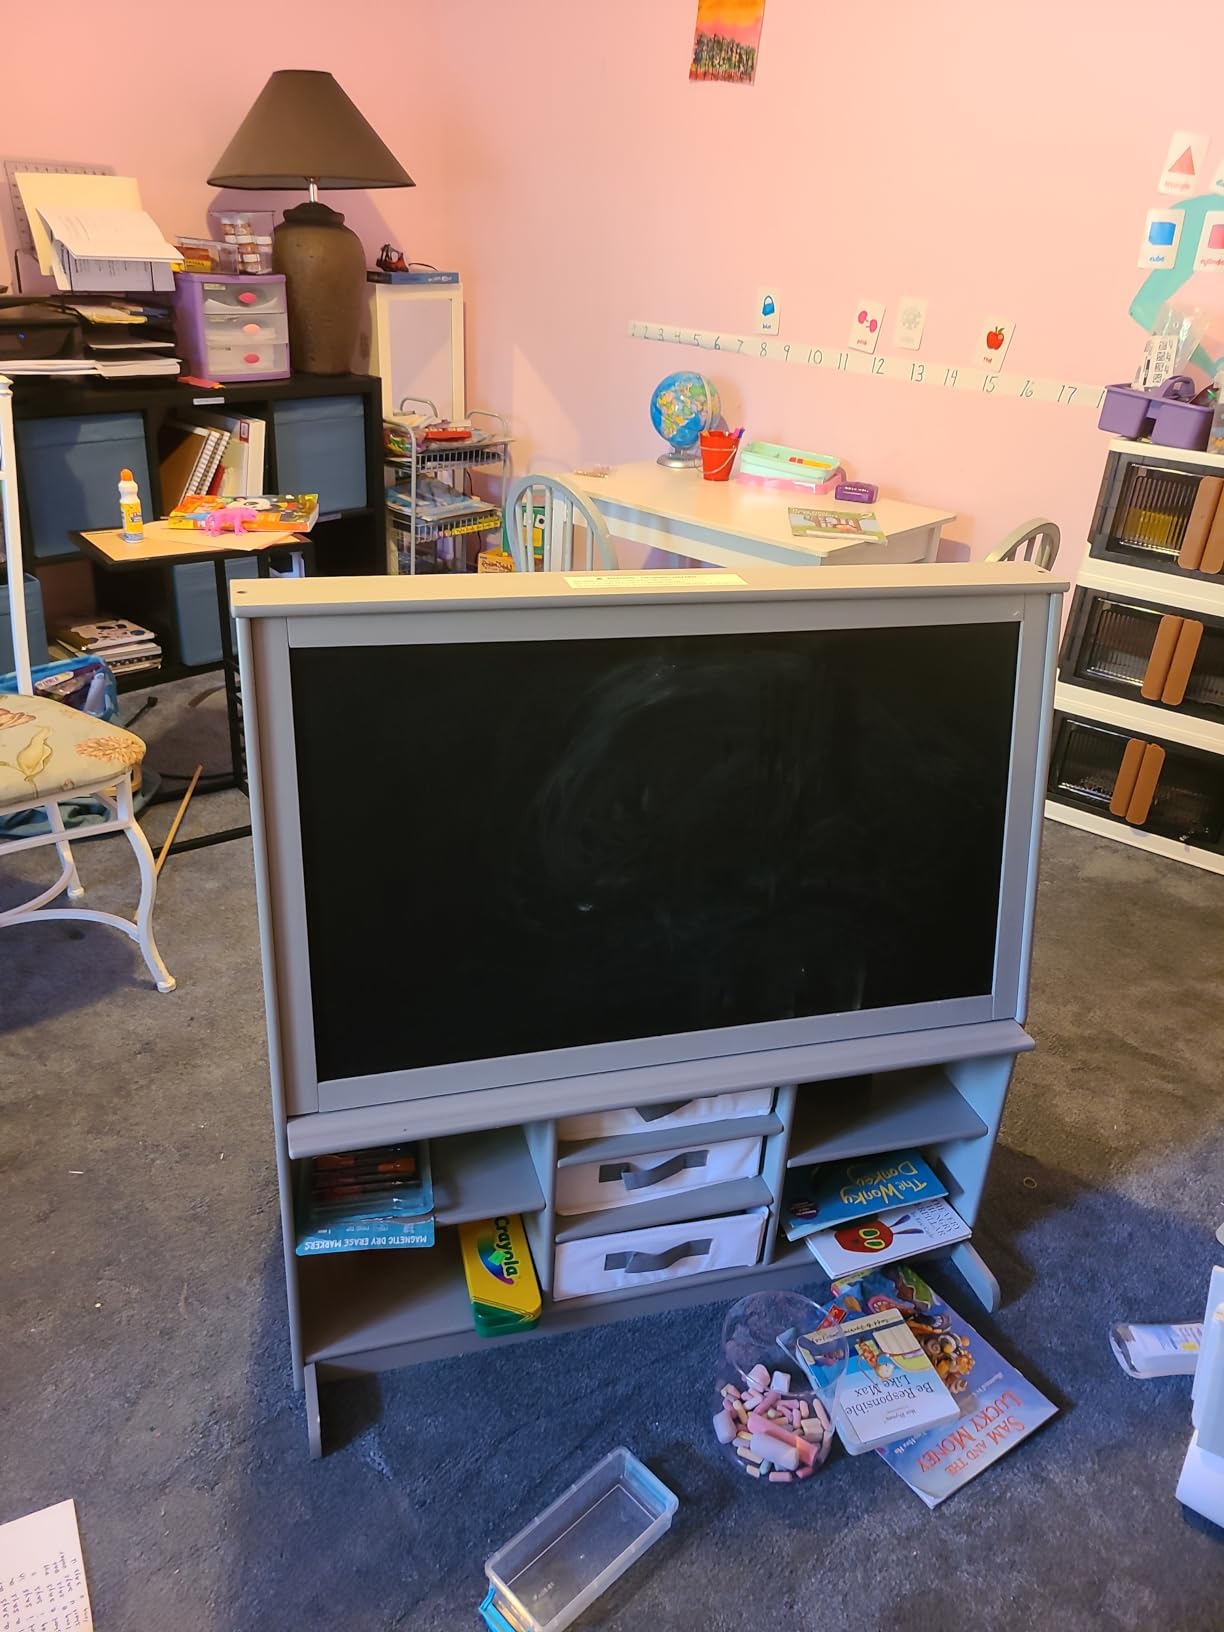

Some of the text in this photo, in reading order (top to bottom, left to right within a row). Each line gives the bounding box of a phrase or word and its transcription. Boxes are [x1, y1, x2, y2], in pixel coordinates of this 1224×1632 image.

[643, 325, 649, 340] 2
[658, 328, 665, 341] 3
[674, 331, 681, 344] 4
[693, 333, 702, 347] 5
[714, 336, 721, 350] 6
[736, 339, 744, 353] 7
[759, 342, 768, 357] 8
[783, 345, 791, 361] 9
[807, 349, 823, 365] 10
[837, 353, 849, 371] 11
[871, 357, 885, 375] 12
[910, 363, 925, 382] 13
[943, 368, 959, 387] 14
[982, 375, 999, 393] 15
[1019, 379, 1035, 398] 16
[1057, 384, 1078, 405] 17
[847, 1160, 918, 1187] Donkey
[840, 1177, 928, 1206] The Wonky
[304, 1235, 428, 1251] MAGNETIC DRY ERASE MARKERS
[495, 1215, 519, 1277] Crayola
[854, 1374, 911, 1398] Like Max
[915, 1382, 935, 1395] Be
[844, 1387, 916, 1416] Responsible
[917, 1391, 1023, 1473] LUCKY MONEY
[944, 1416, 1025, 1477] SAM AND THE
